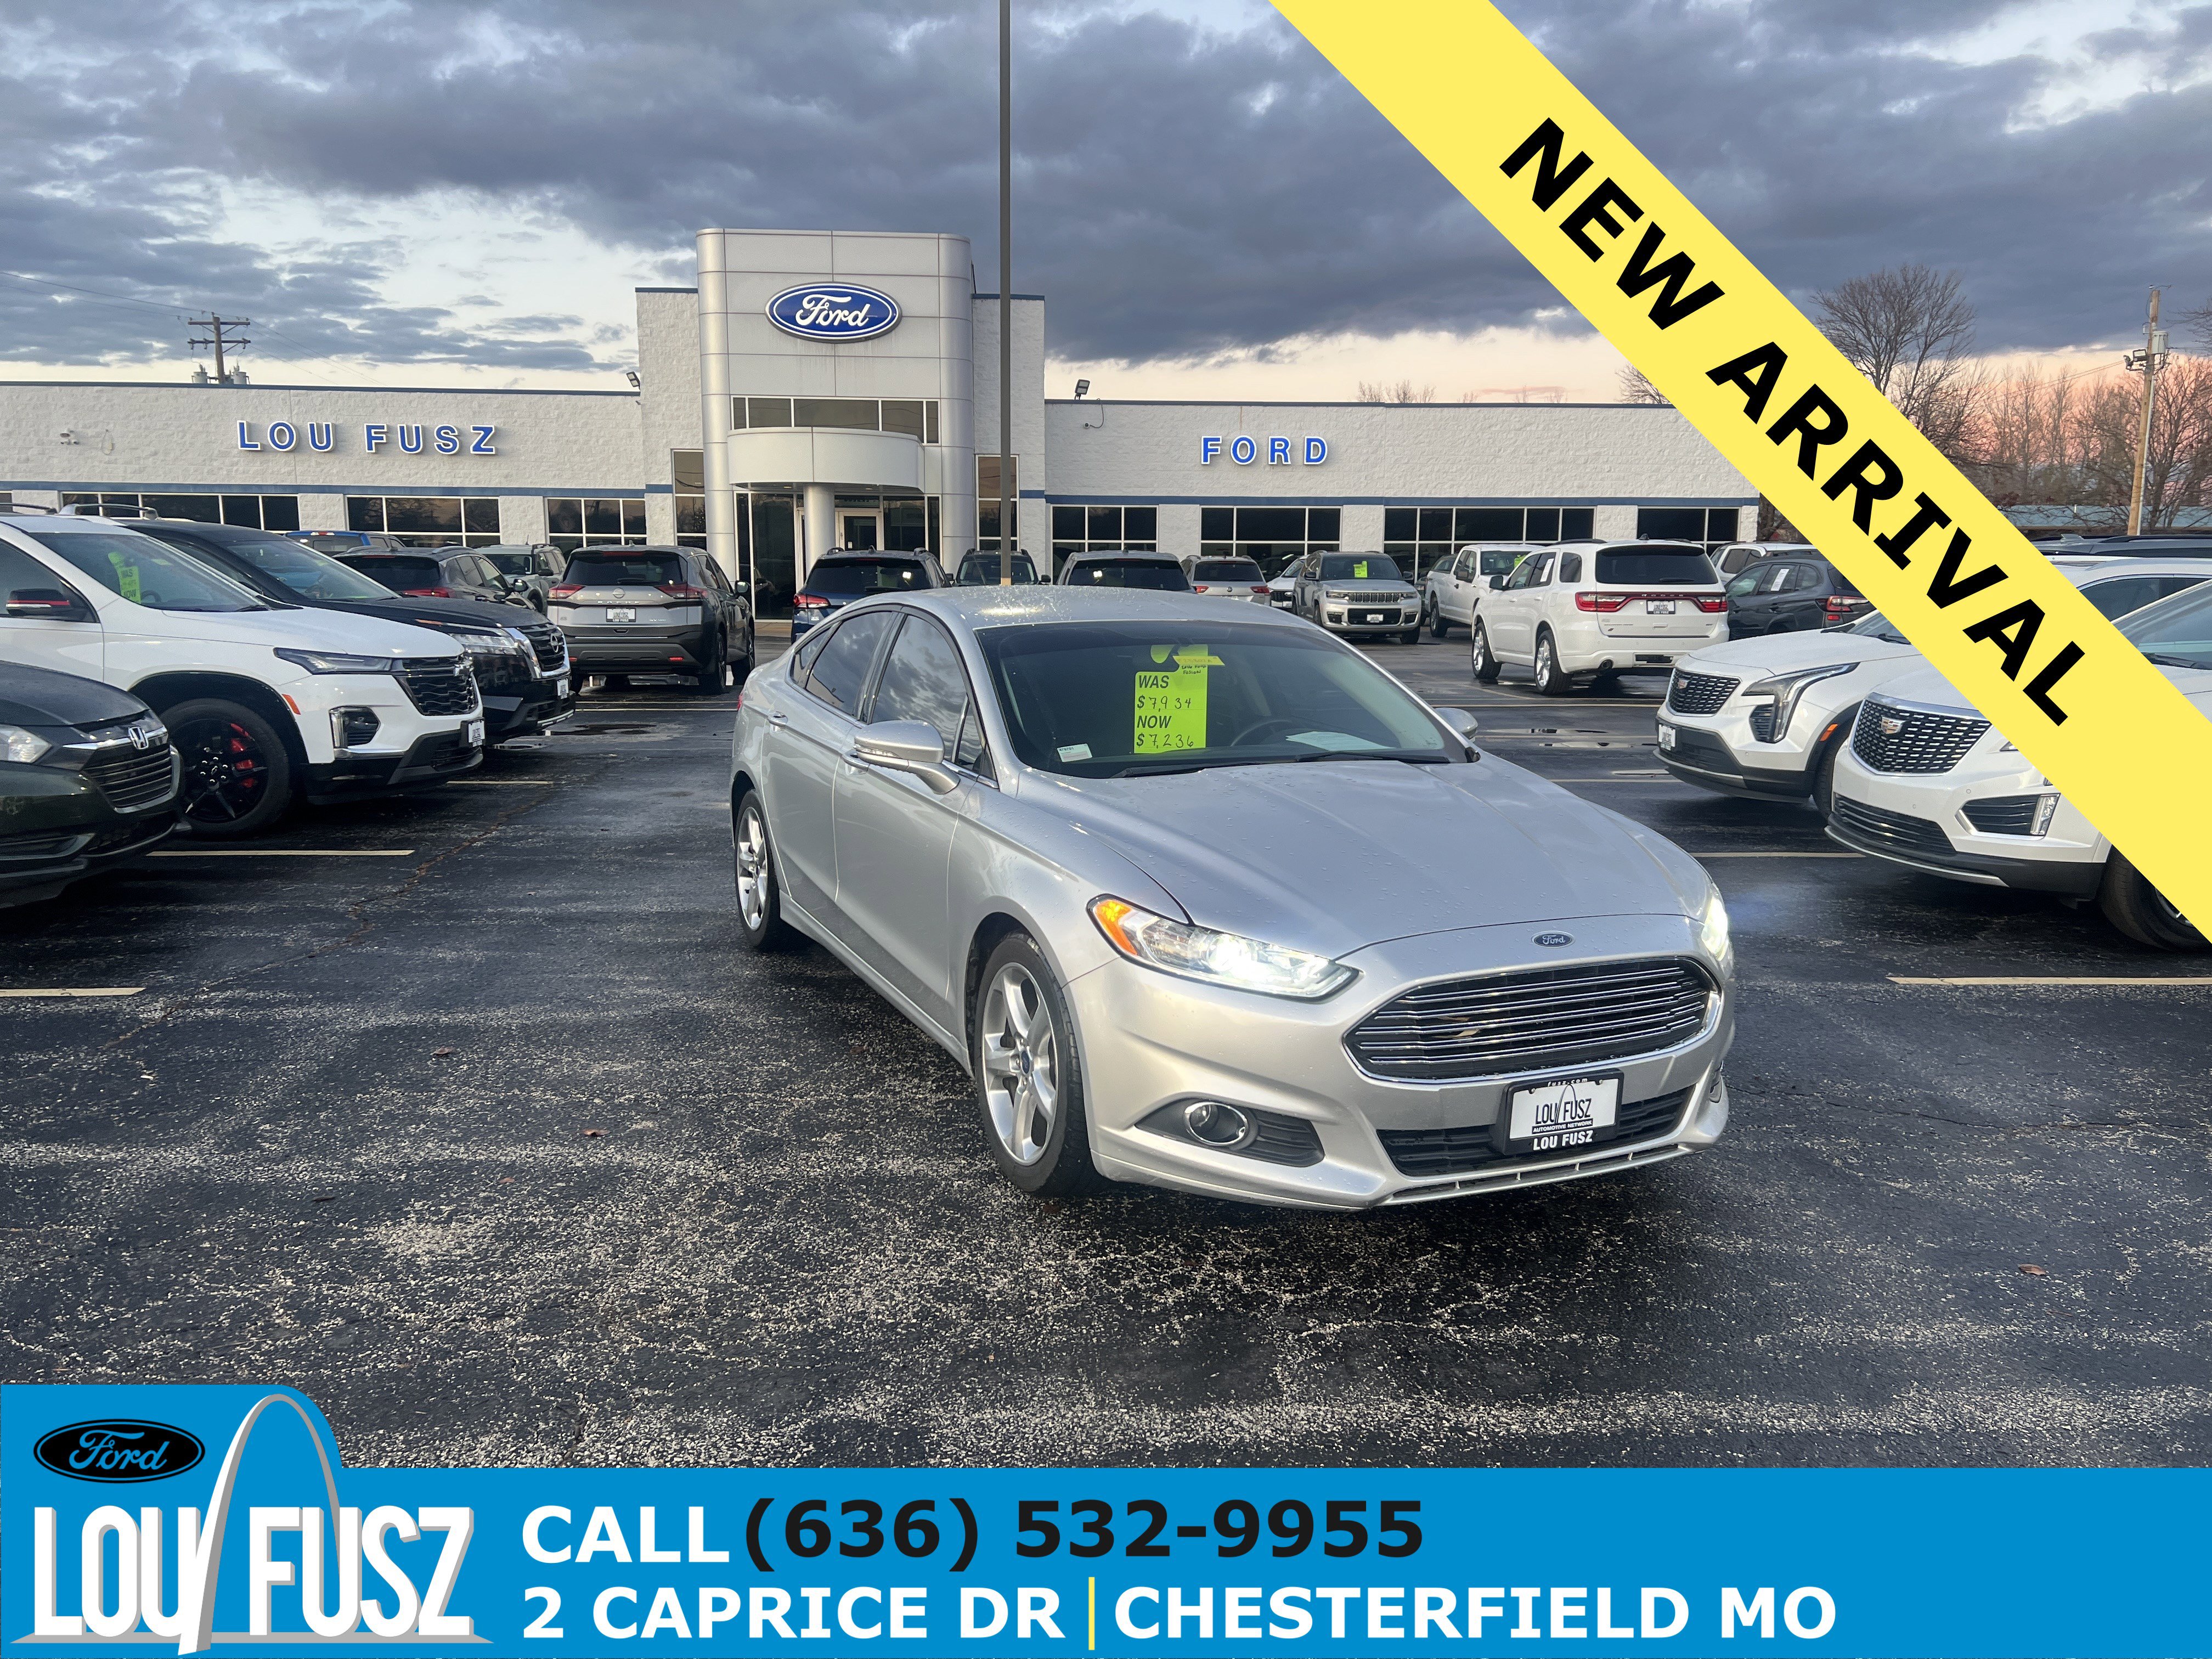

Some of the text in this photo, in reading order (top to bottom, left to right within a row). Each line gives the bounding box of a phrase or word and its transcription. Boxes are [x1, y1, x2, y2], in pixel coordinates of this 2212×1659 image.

[795, 294, 871, 326] Ford
[236, 420, 496, 454] LOU FUSZ
[1201, 435, 1328, 465] FORD
[1138, 675, 1170, 689] WAS
[1137, 715, 1172, 729] NOW
[1542, 934, 1566, 945] Ford
[1547, 1078, 1588, 1087] fusz.com
[1535, 1098, 1592, 1125] LOU FUSZ
[1533, 1120, 1592, 1133] AUTOMOTIVE NETWORK
[1533, 1130, 1594, 1151] LOU FUSZ
